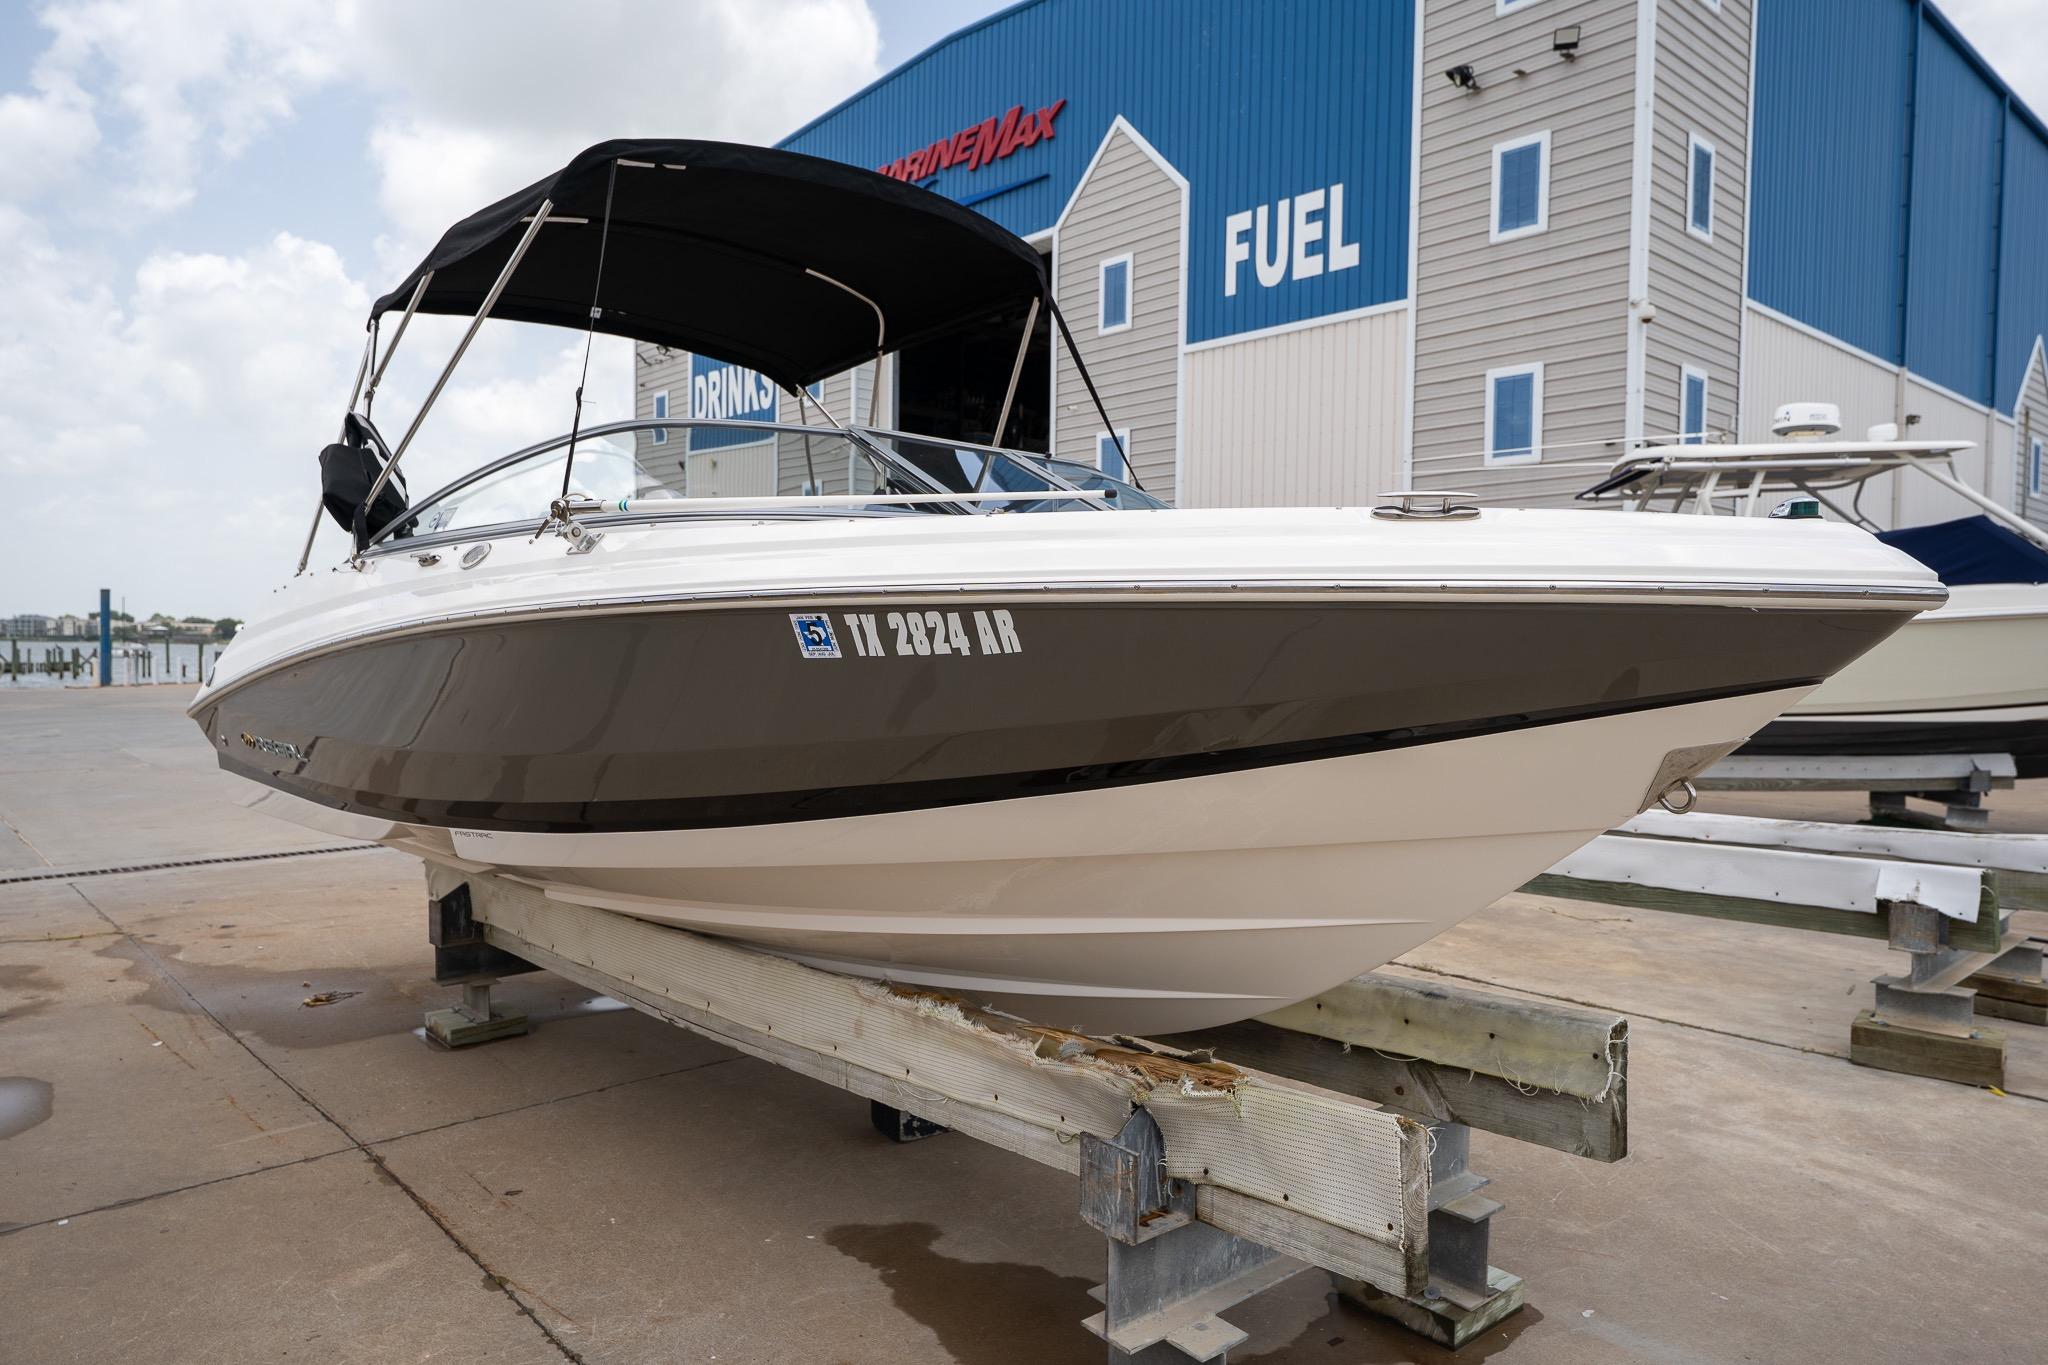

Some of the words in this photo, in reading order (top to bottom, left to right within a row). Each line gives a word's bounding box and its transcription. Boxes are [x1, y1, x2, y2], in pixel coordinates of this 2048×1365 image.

[877, 98, 1066, 182] ARINEMAX
[1225, 182, 1360, 297] FUEL
[694, 365, 774, 418] DRINKS
[806, 622, 823, 646] 5
[843, 613, 886, 657] TX
[887, 610, 971, 656] 2824
[972, 609, 1023, 655] AR
